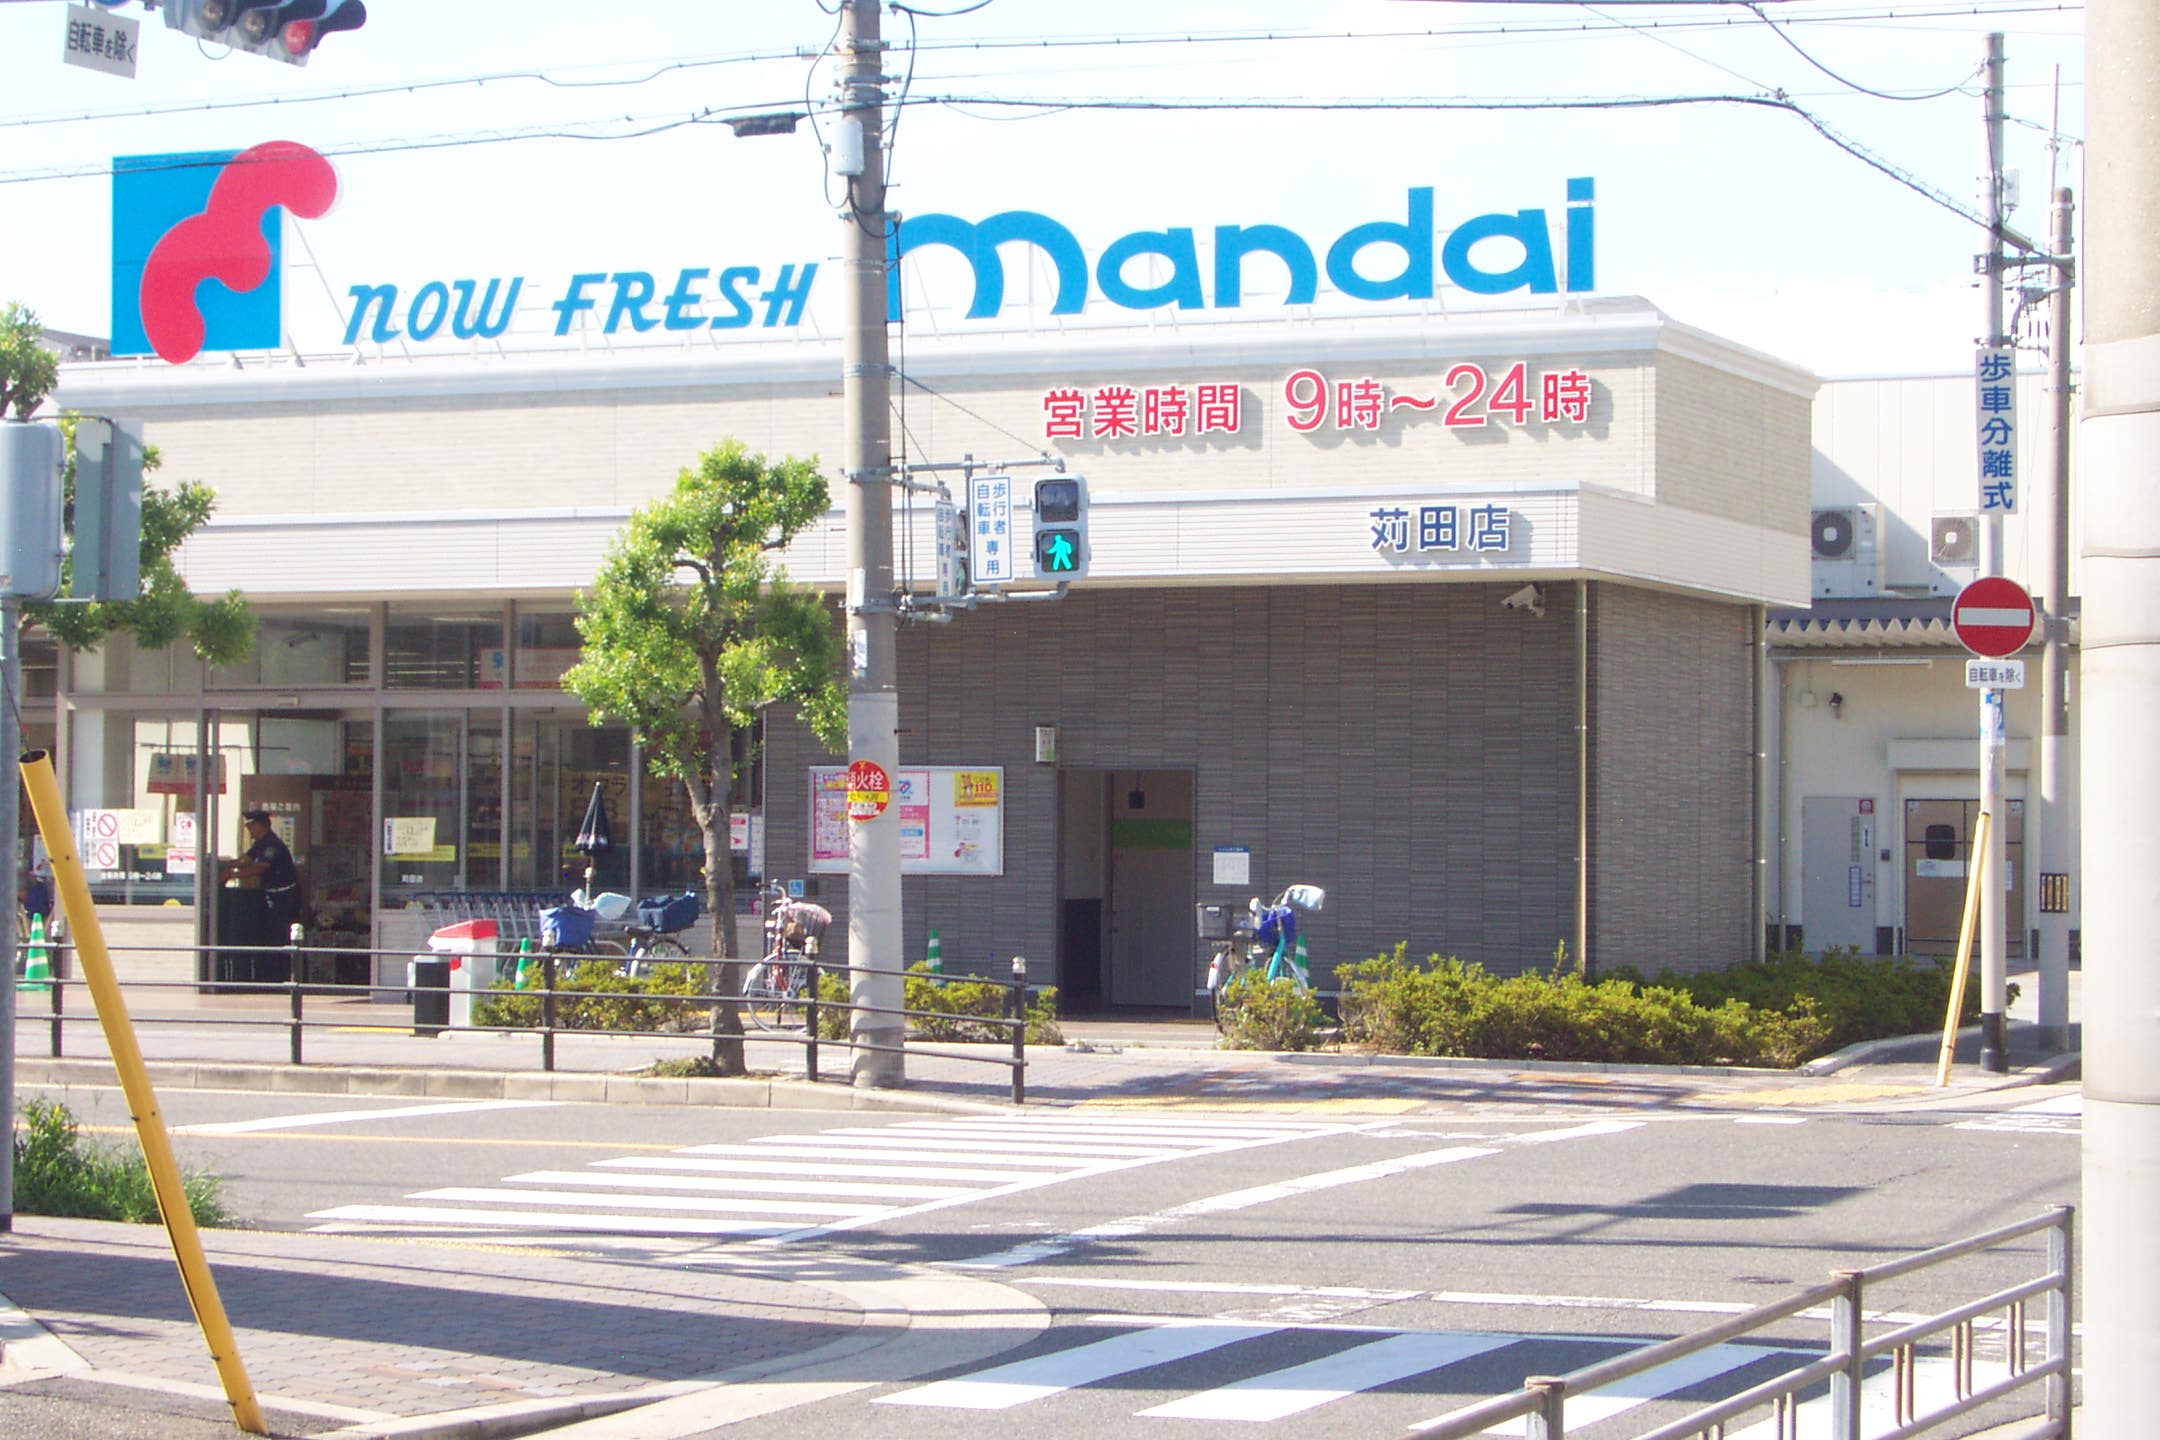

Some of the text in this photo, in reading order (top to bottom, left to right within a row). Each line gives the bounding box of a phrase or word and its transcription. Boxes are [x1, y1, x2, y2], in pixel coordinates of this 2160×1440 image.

[886, 176, 1596, 323] mandai
[552, 263, 820, 336] FRESH
[1043, 383, 1242, 439] 営業時間
[1979, 353, 2014, 511] 歩車分離式
[1369, 504, 1511, 552] 苅田店
